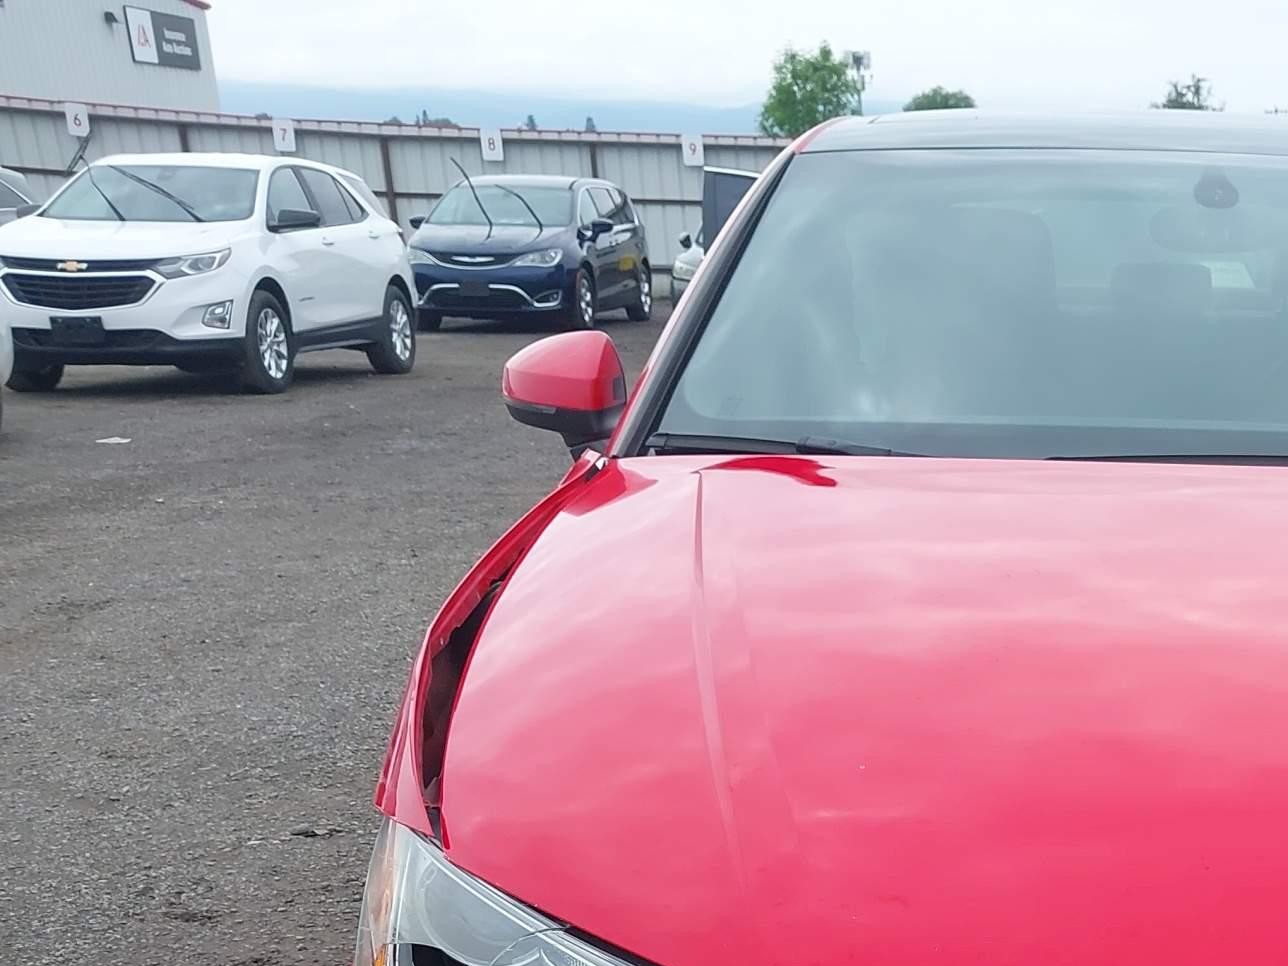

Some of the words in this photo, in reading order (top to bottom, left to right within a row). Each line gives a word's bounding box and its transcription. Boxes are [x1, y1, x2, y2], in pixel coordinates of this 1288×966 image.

[73, 113, 82, 127] 6
[278, 127, 287, 142] 7
[487, 137, 496, 151] 8
[688, 142, 697, 156] 9
